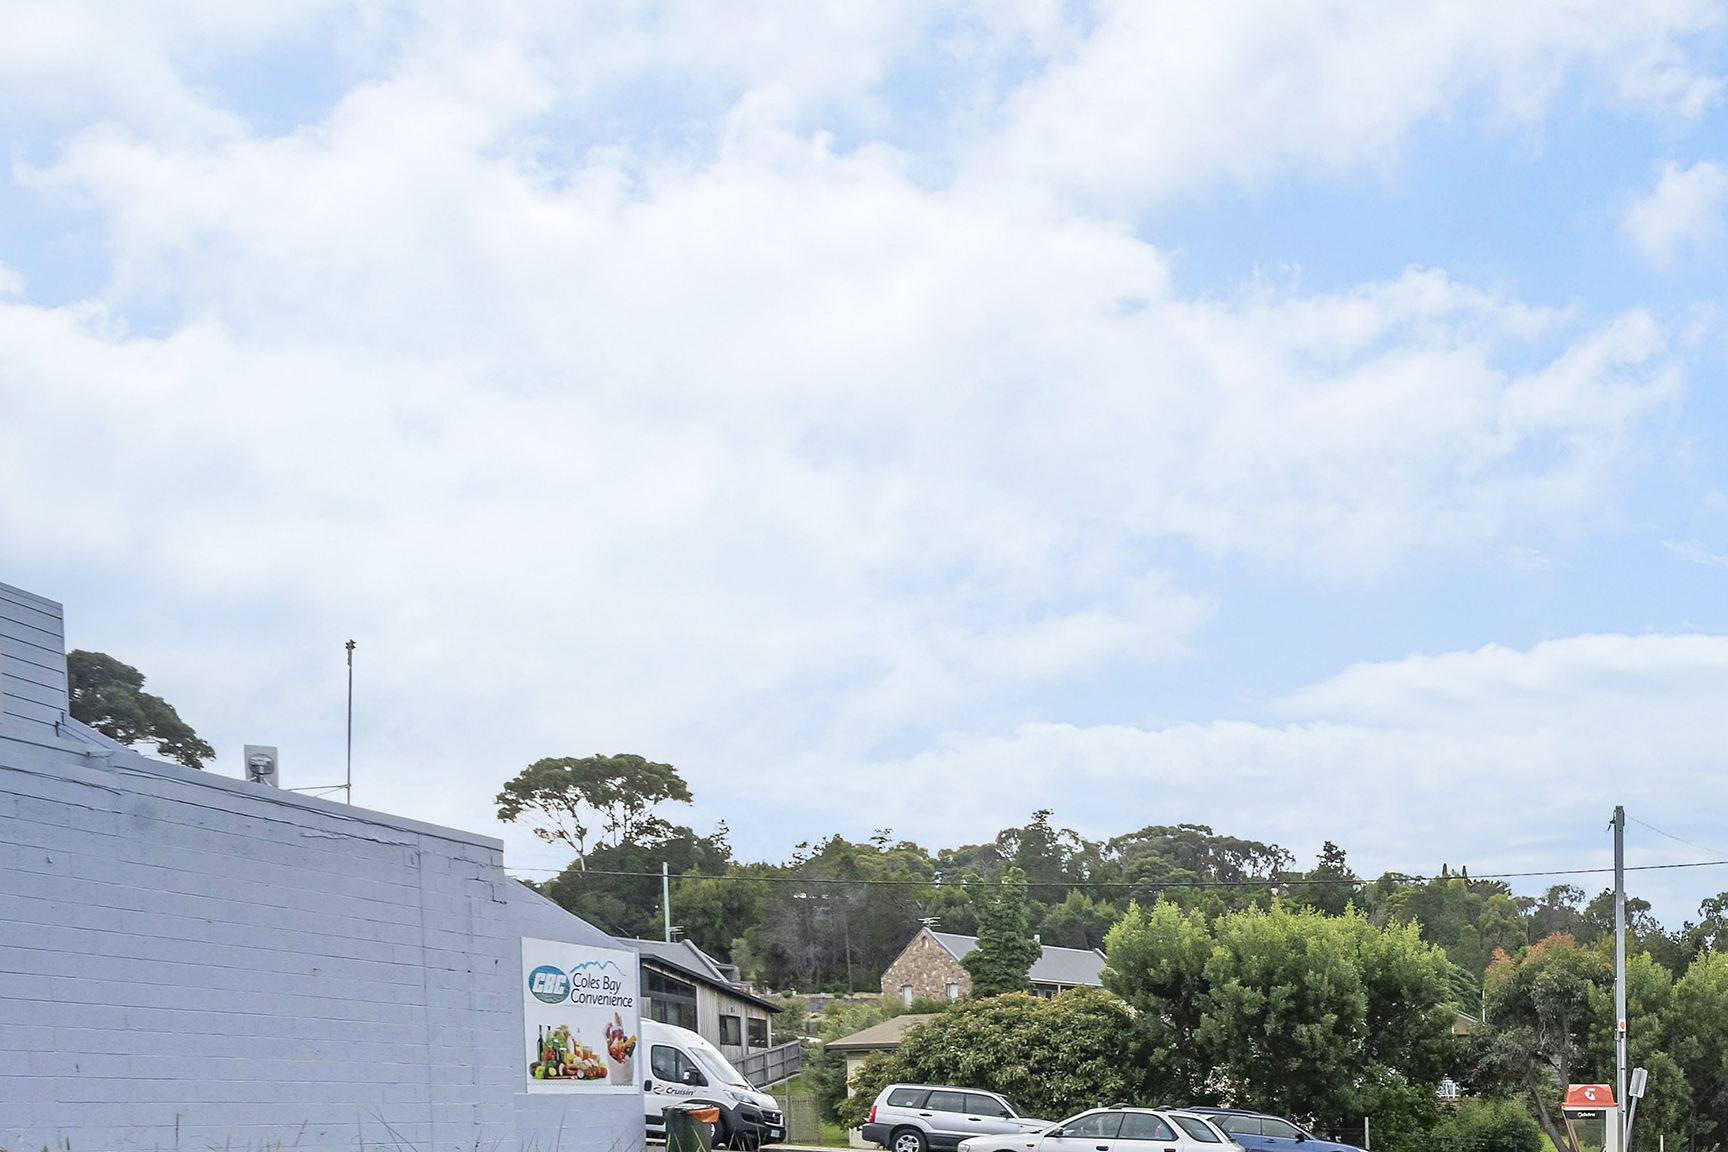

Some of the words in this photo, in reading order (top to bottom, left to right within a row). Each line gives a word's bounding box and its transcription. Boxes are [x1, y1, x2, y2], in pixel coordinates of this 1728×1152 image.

[532, 972, 567, 995] CBC
[572, 972, 600, 989] Coles
[602, 975, 622, 995] Bay
[570, 988, 633, 1007] Convenience
